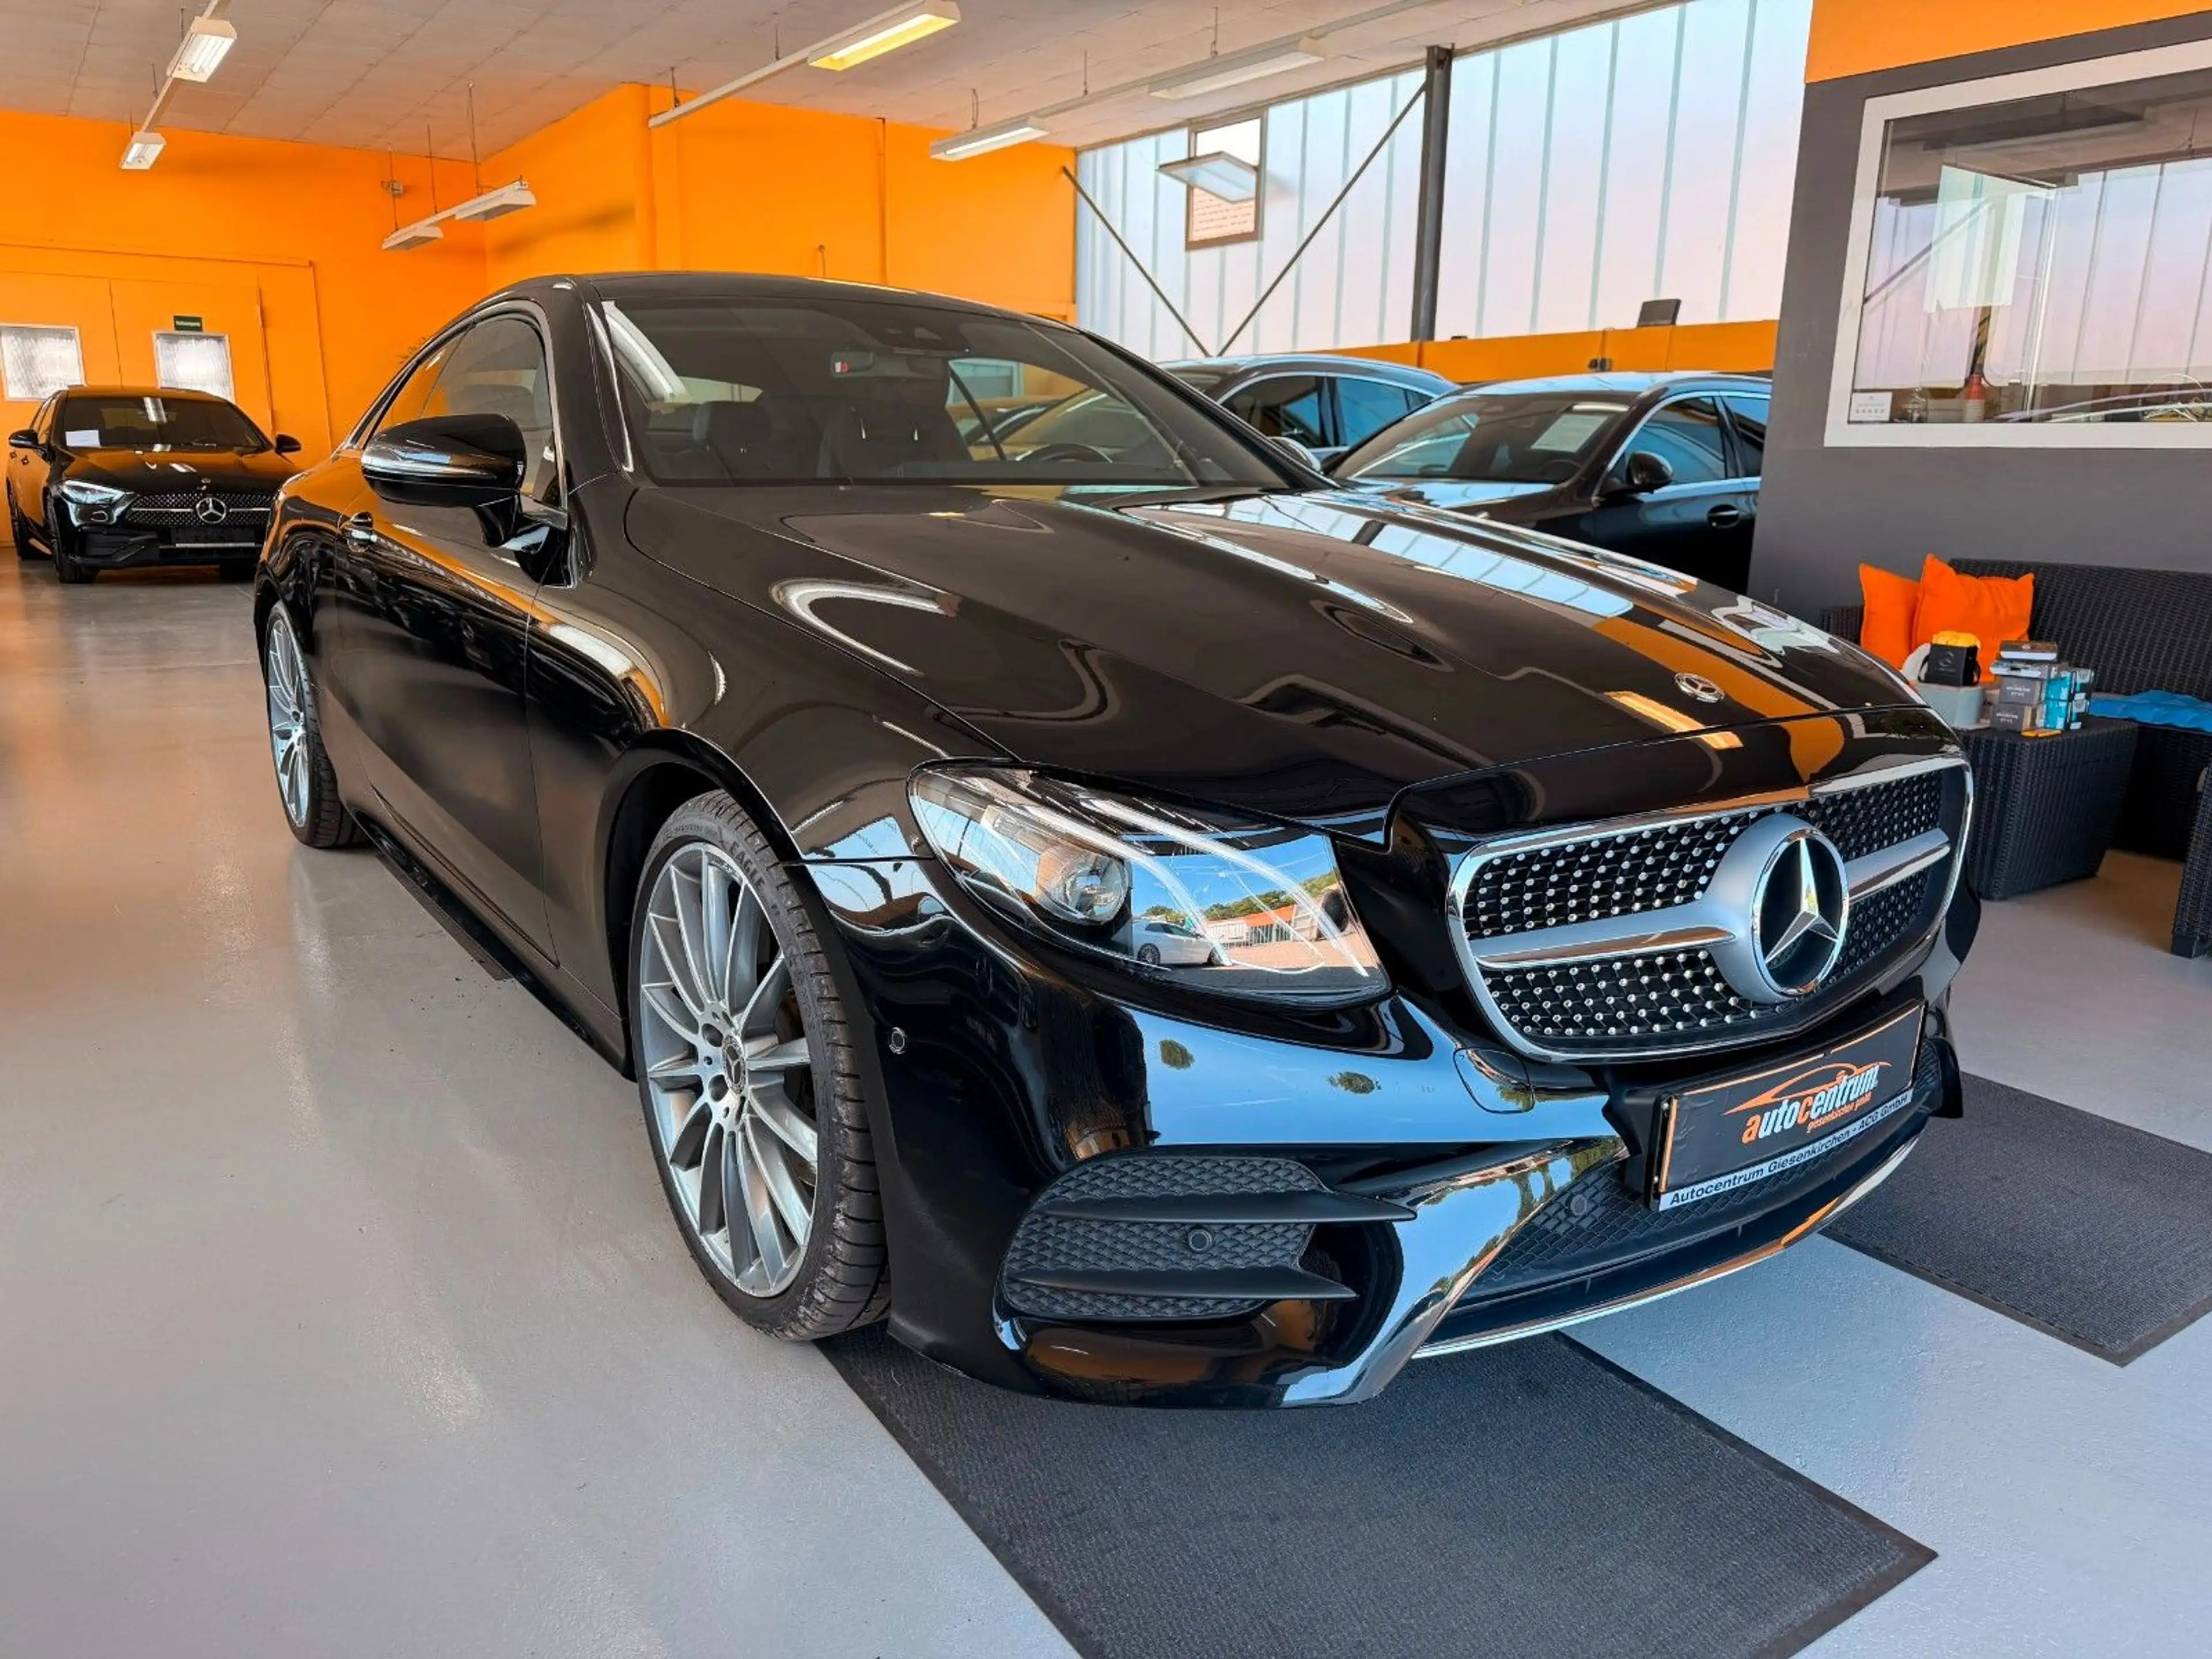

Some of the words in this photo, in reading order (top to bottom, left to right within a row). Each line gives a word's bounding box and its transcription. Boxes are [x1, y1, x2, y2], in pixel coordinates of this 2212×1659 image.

[729, 841, 765, 891] EAGLE
[1741, 1065, 1880, 1144] autocentrum
[1670, 1168, 1764, 1205] Autocentrum
[1768, 1130, 1850, 1172] Giesenkirchen
[1880, 1093, 1907, 1116] GmbH
